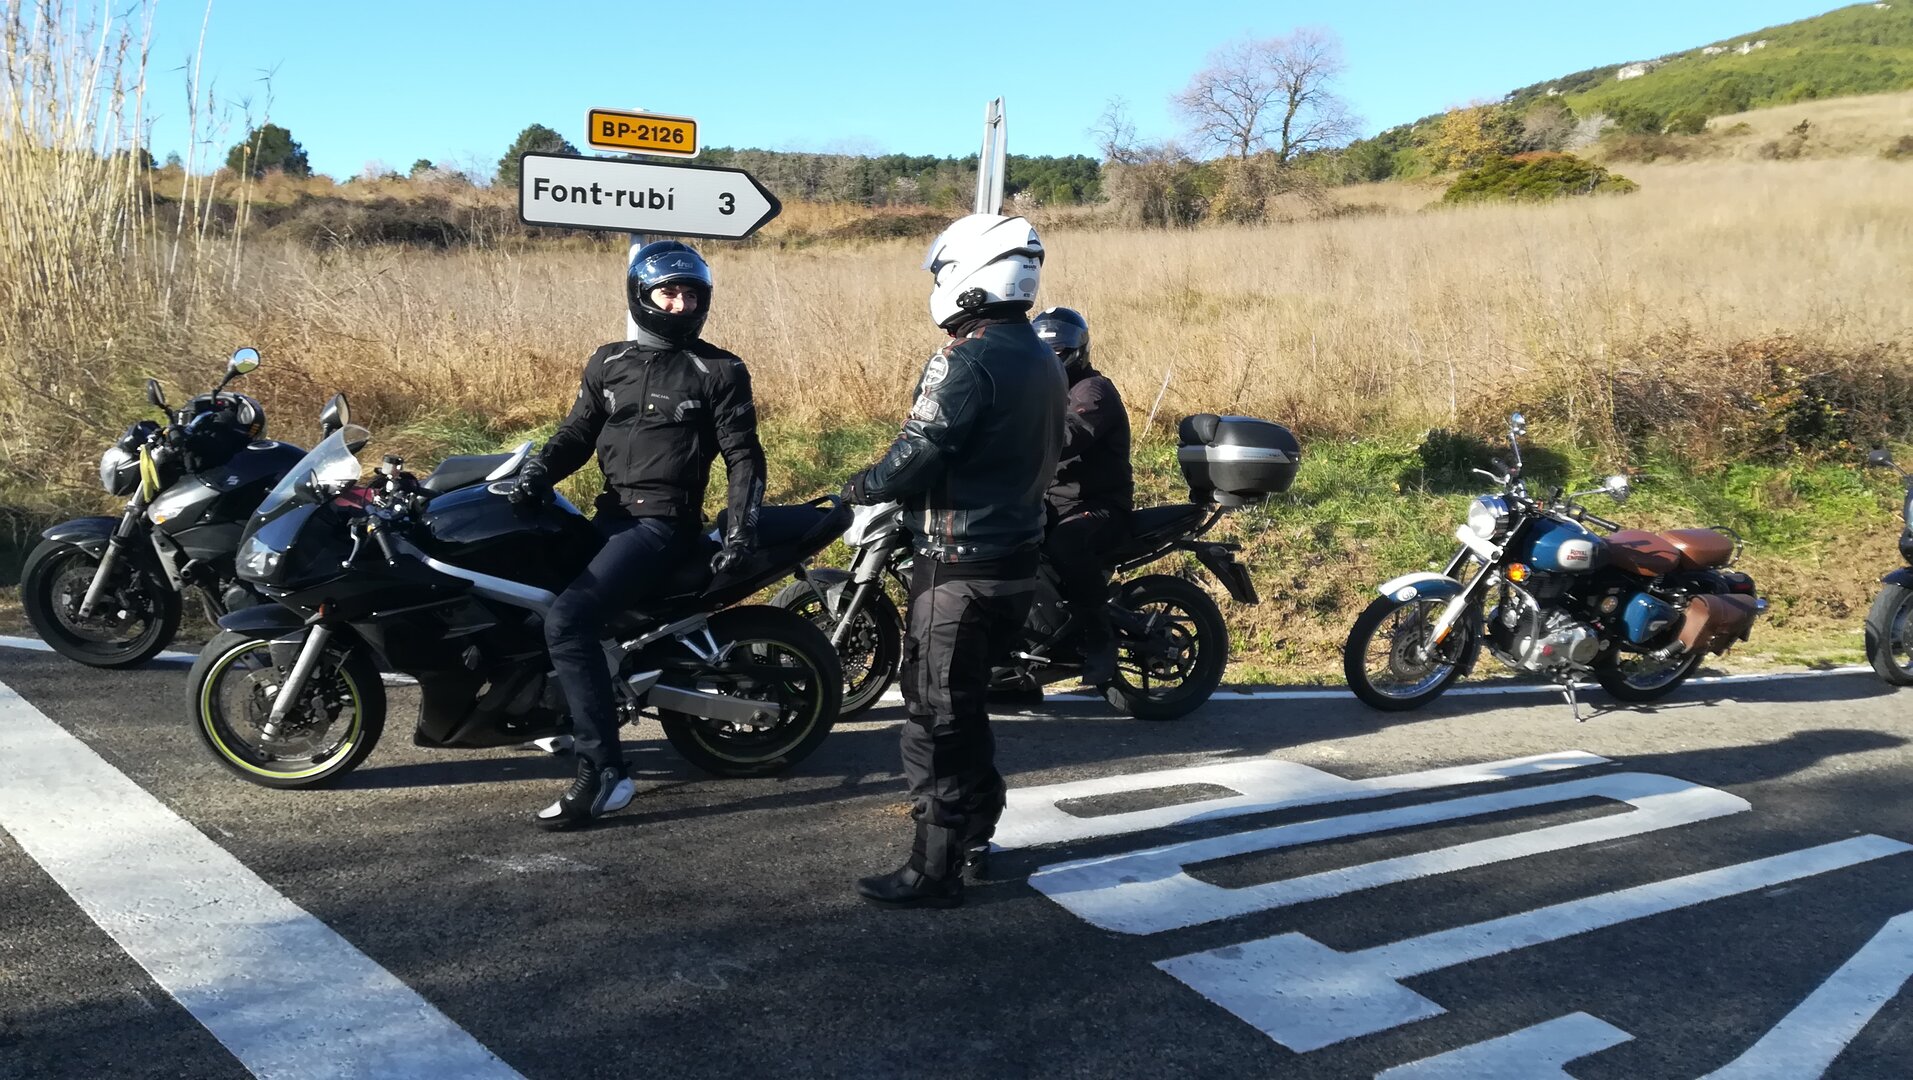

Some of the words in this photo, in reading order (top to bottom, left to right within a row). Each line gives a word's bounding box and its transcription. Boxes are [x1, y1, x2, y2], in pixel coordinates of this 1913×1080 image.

[602, 120, 684, 144] BP-2126
[533, 177, 675, 211] Font-rubí
[718, 192, 736, 216] 3
